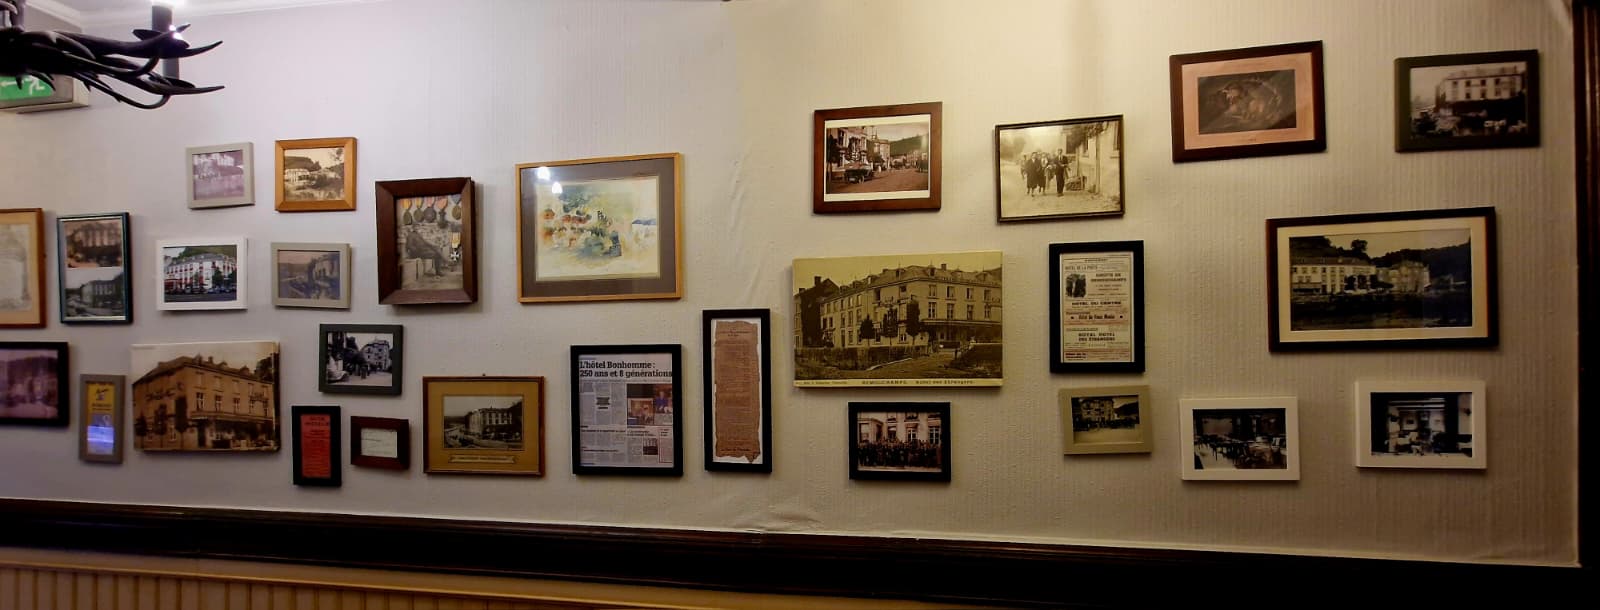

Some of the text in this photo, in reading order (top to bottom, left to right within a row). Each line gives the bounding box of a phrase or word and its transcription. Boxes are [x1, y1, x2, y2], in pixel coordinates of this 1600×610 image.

[580, 360, 606, 369] L'hôtel
[607, 360, 652, 369] Bonhomme
[625, 370, 672, 378] générations
